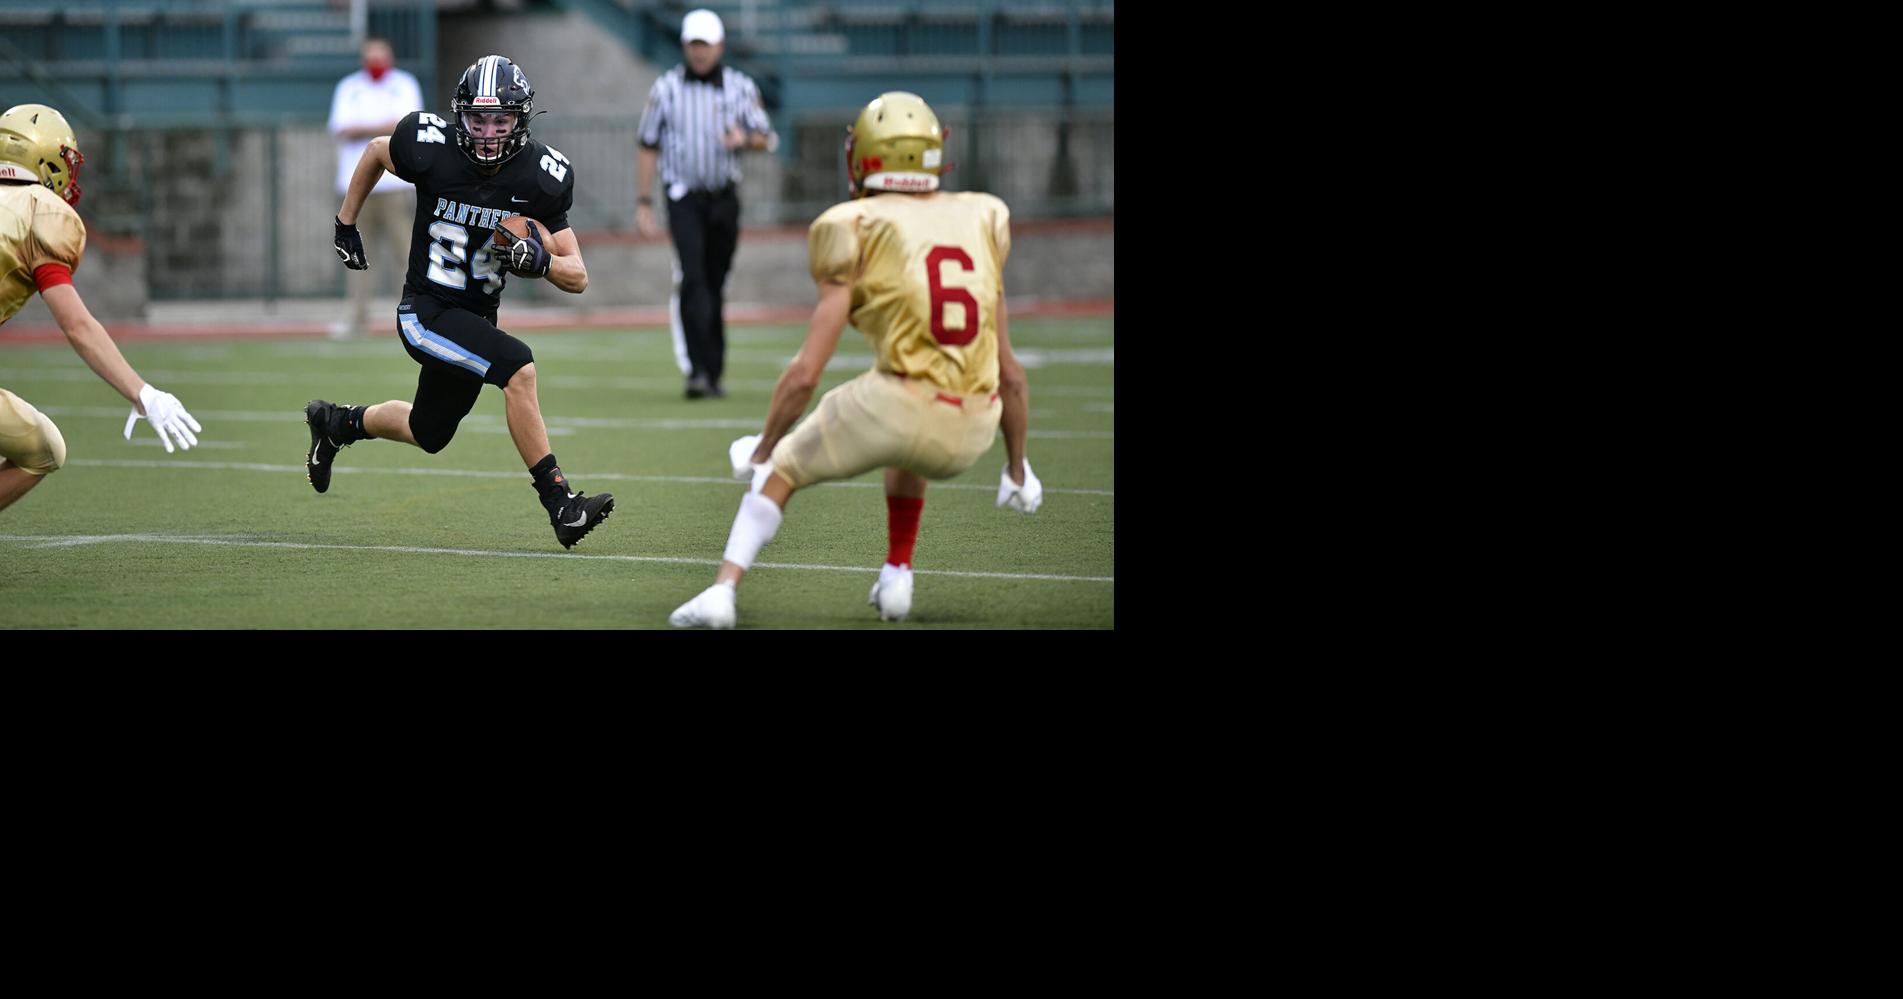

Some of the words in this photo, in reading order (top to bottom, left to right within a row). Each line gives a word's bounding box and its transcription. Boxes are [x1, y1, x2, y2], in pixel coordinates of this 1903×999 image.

[416, 111, 447, 145] 24
[426, 220, 505, 295] 24
[925, 245, 979, 347] 6
